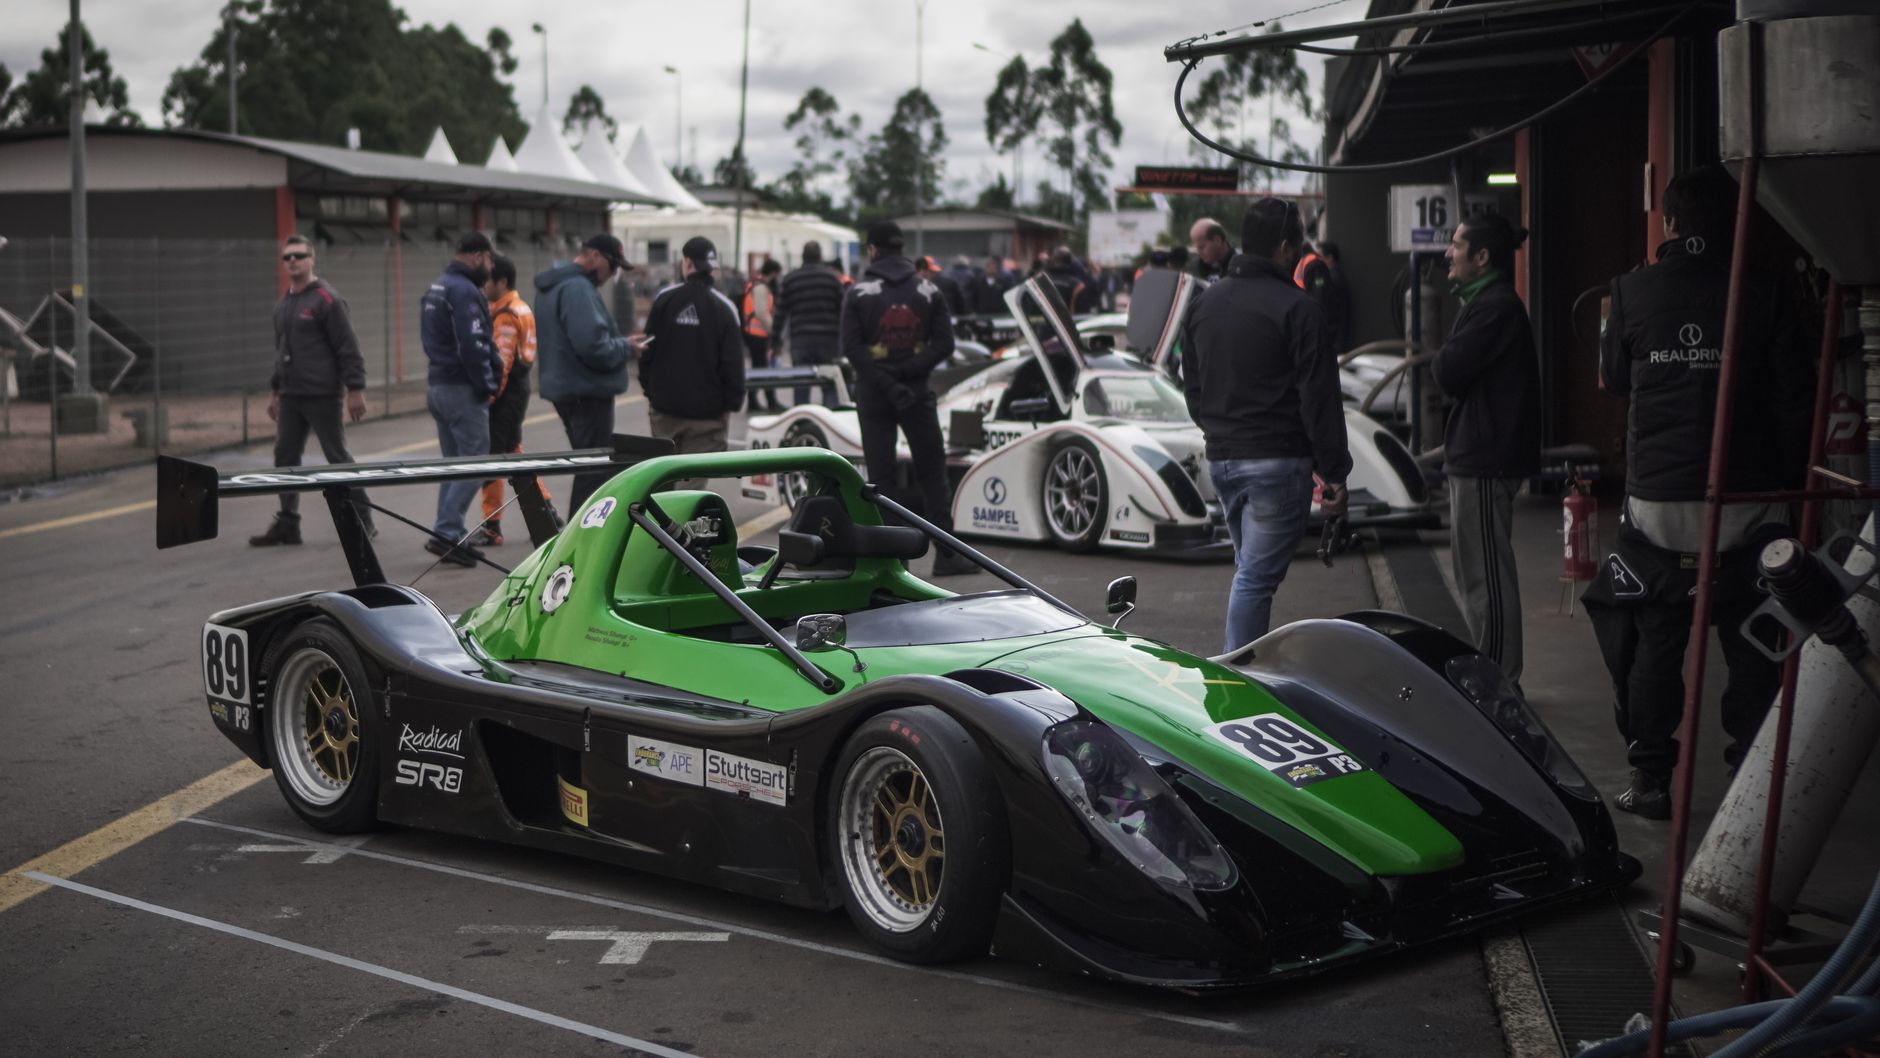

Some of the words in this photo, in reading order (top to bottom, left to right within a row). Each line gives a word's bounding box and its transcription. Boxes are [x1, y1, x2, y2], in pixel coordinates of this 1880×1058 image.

[1416, 196, 1447, 227] 16
[1650, 349, 1723, 363] REALDRIV
[973, 507, 1018, 525] SAMPEL
[206, 629, 246, 700] 89
[235, 706, 250, 730] P3
[399, 723, 463, 753] Radical
[1219, 717, 1329, 763] 89
[670, 753, 693, 774] APE
[708, 755, 785, 790] Stuttgart
[1327, 755, 1362, 773] P3
